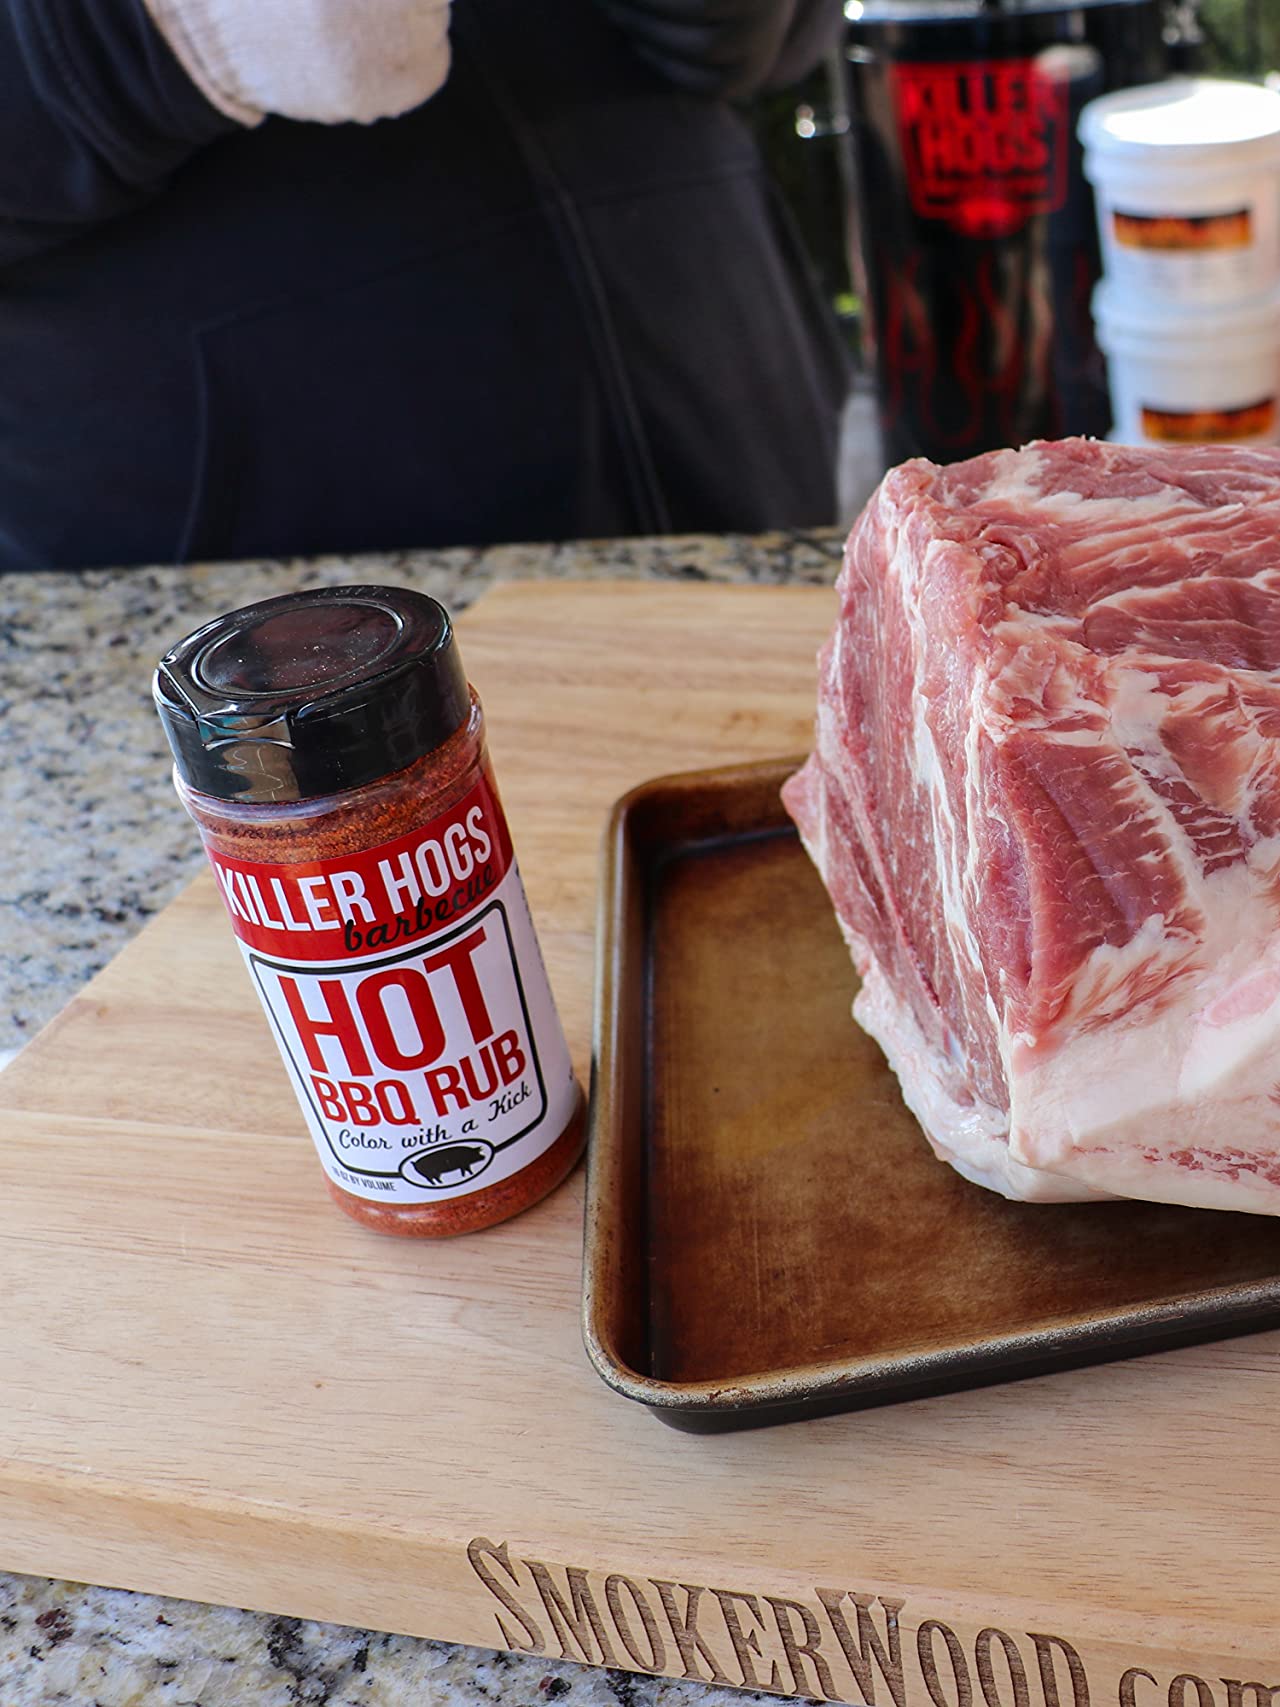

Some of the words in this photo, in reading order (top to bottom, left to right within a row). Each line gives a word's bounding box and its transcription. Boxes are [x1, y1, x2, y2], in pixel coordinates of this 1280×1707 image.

[214, 861, 377, 932] KILLER
[378, 805, 492, 914] HOGS
[343, 864, 498, 951] barbecue
[277, 927, 495, 1077] HOT
[311, 1075, 422, 1127] BBQ
[424, 1029, 526, 1117] RUB
[339, 1128, 393, 1150] Color
[401, 1124, 452, 1148] with
[461, 1119, 478, 1133] a
[487, 1081, 533, 1122] Kick
[349, 1173, 361, 1186] BY
[360, 1178, 397, 1192] VOLUME
